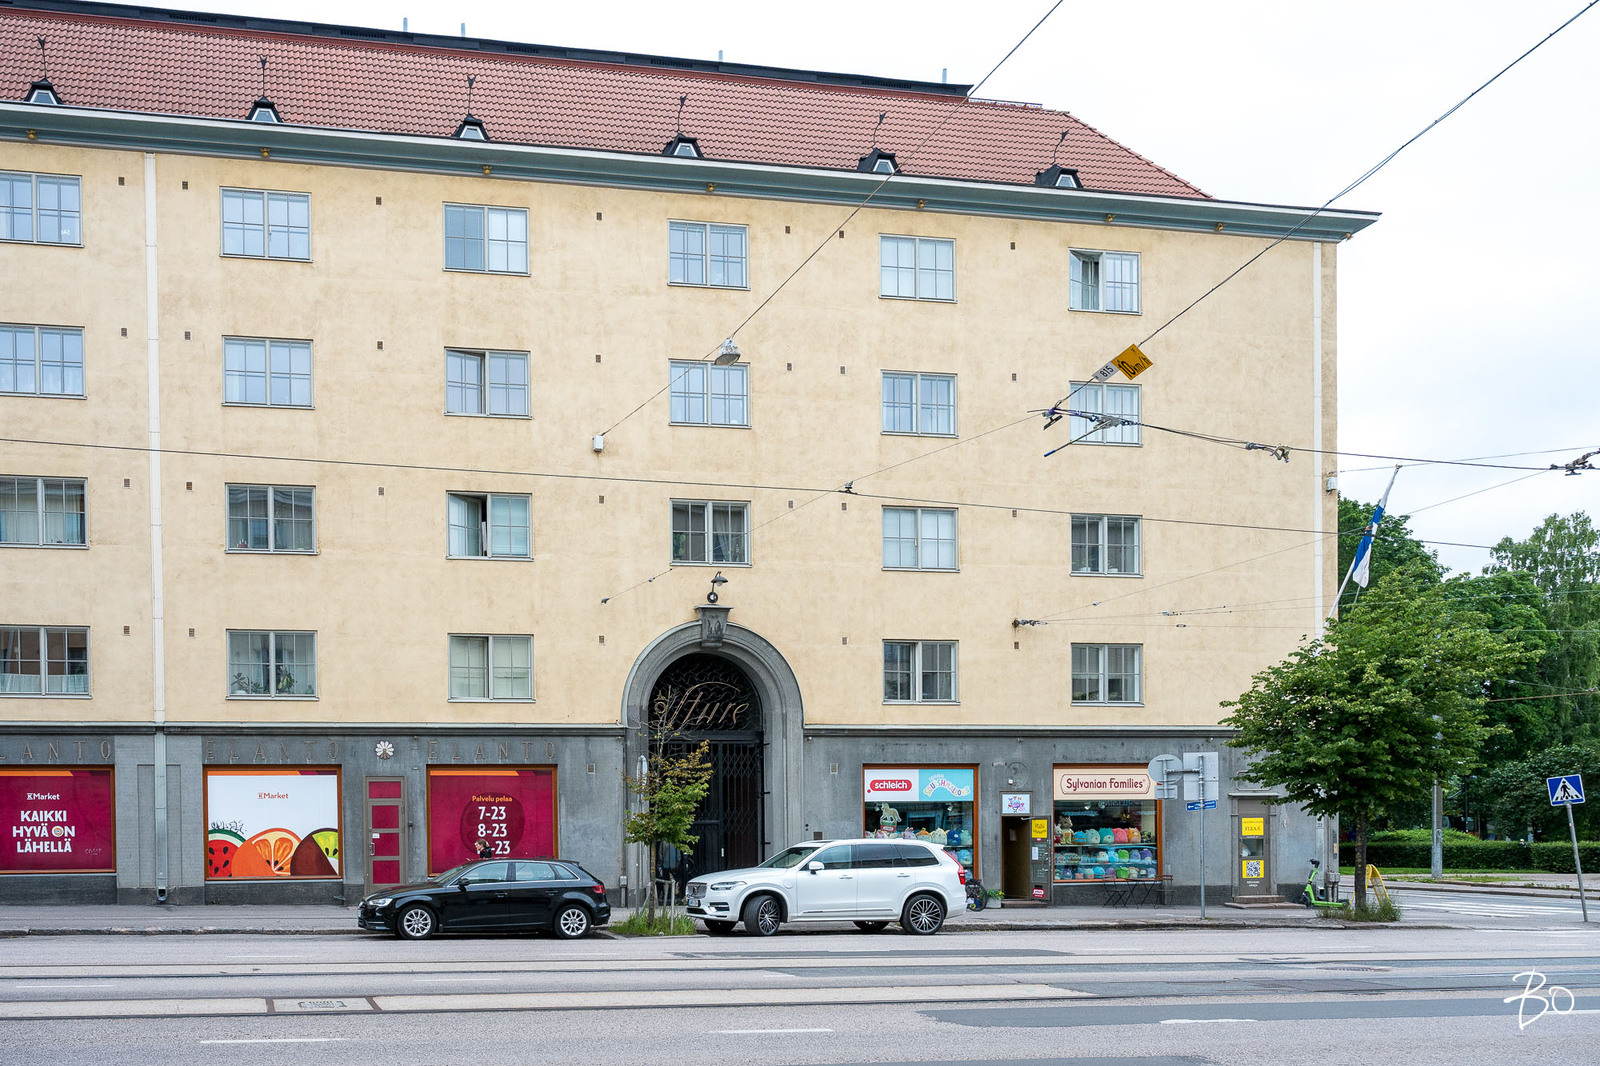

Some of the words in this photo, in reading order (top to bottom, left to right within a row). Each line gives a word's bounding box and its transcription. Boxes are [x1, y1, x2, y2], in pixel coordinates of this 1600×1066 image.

[1100, 366, 1114, 377] 815
[205, 740, 339, 760] ELANTO
[427, 740, 556, 760] ELANTO
[874, 780, 908, 790] schleich
[1066, 778, 1107, 792] Sylvanian
[1109, 777, 1143, 789] Families
[495, 795, 513, 803] pelaa
[20, 810, 67, 822] KAIKKI
[478, 806, 507, 820] 7-23
[12, 823, 49, 838] HYVÄ
[51, 825, 76, 838] ON
[477, 823, 508, 837] 8-23
[17, 838, 72, 853] LÄHELLÄ
